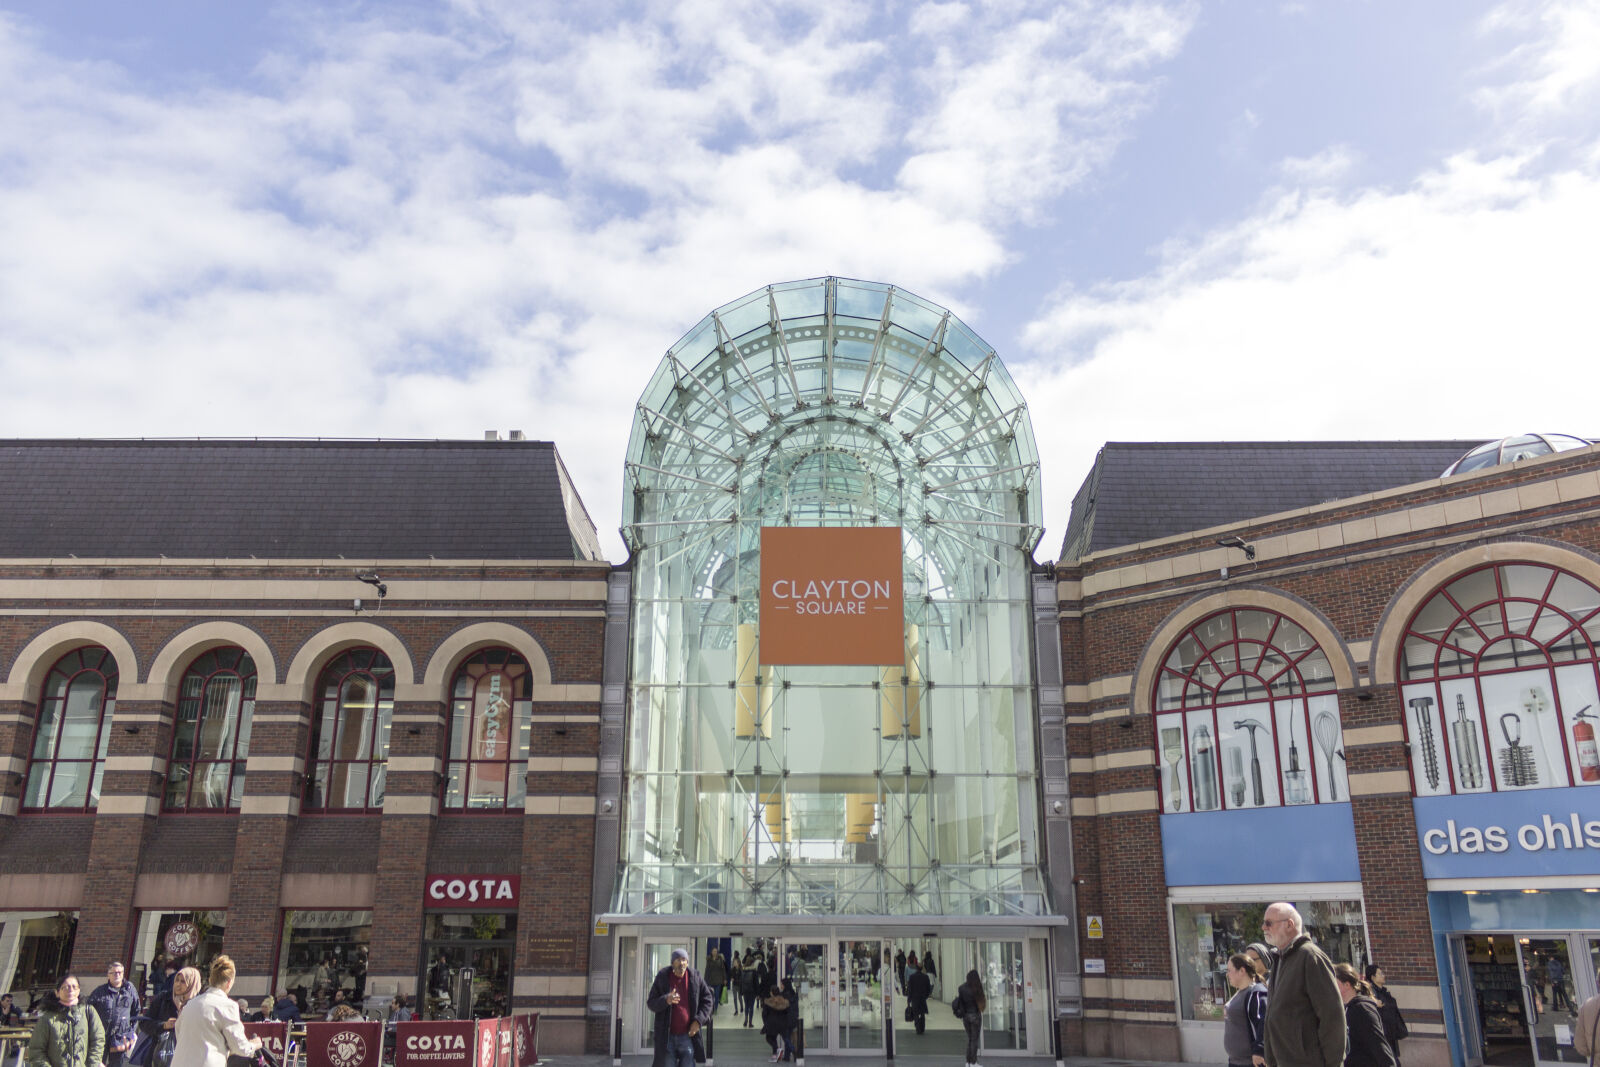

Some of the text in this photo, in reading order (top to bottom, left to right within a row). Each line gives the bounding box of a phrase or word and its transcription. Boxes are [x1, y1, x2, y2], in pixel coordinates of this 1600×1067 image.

[771, 579, 890, 599] CLAYTON
[795, 601, 867, 615] SQUARE
[1423, 812, 1600, 855] clas ohls
[429, 879, 514, 902] COSTA
[172, 924, 195, 934] COSTA
[168, 941, 195, 953] COFFEE
[332, 1032, 360, 1045] COSTA
[406, 1035, 466, 1051] COSTA
[330, 1054, 364, 1067] COFFEE
[442, 1052, 465, 1060] LOVERS
